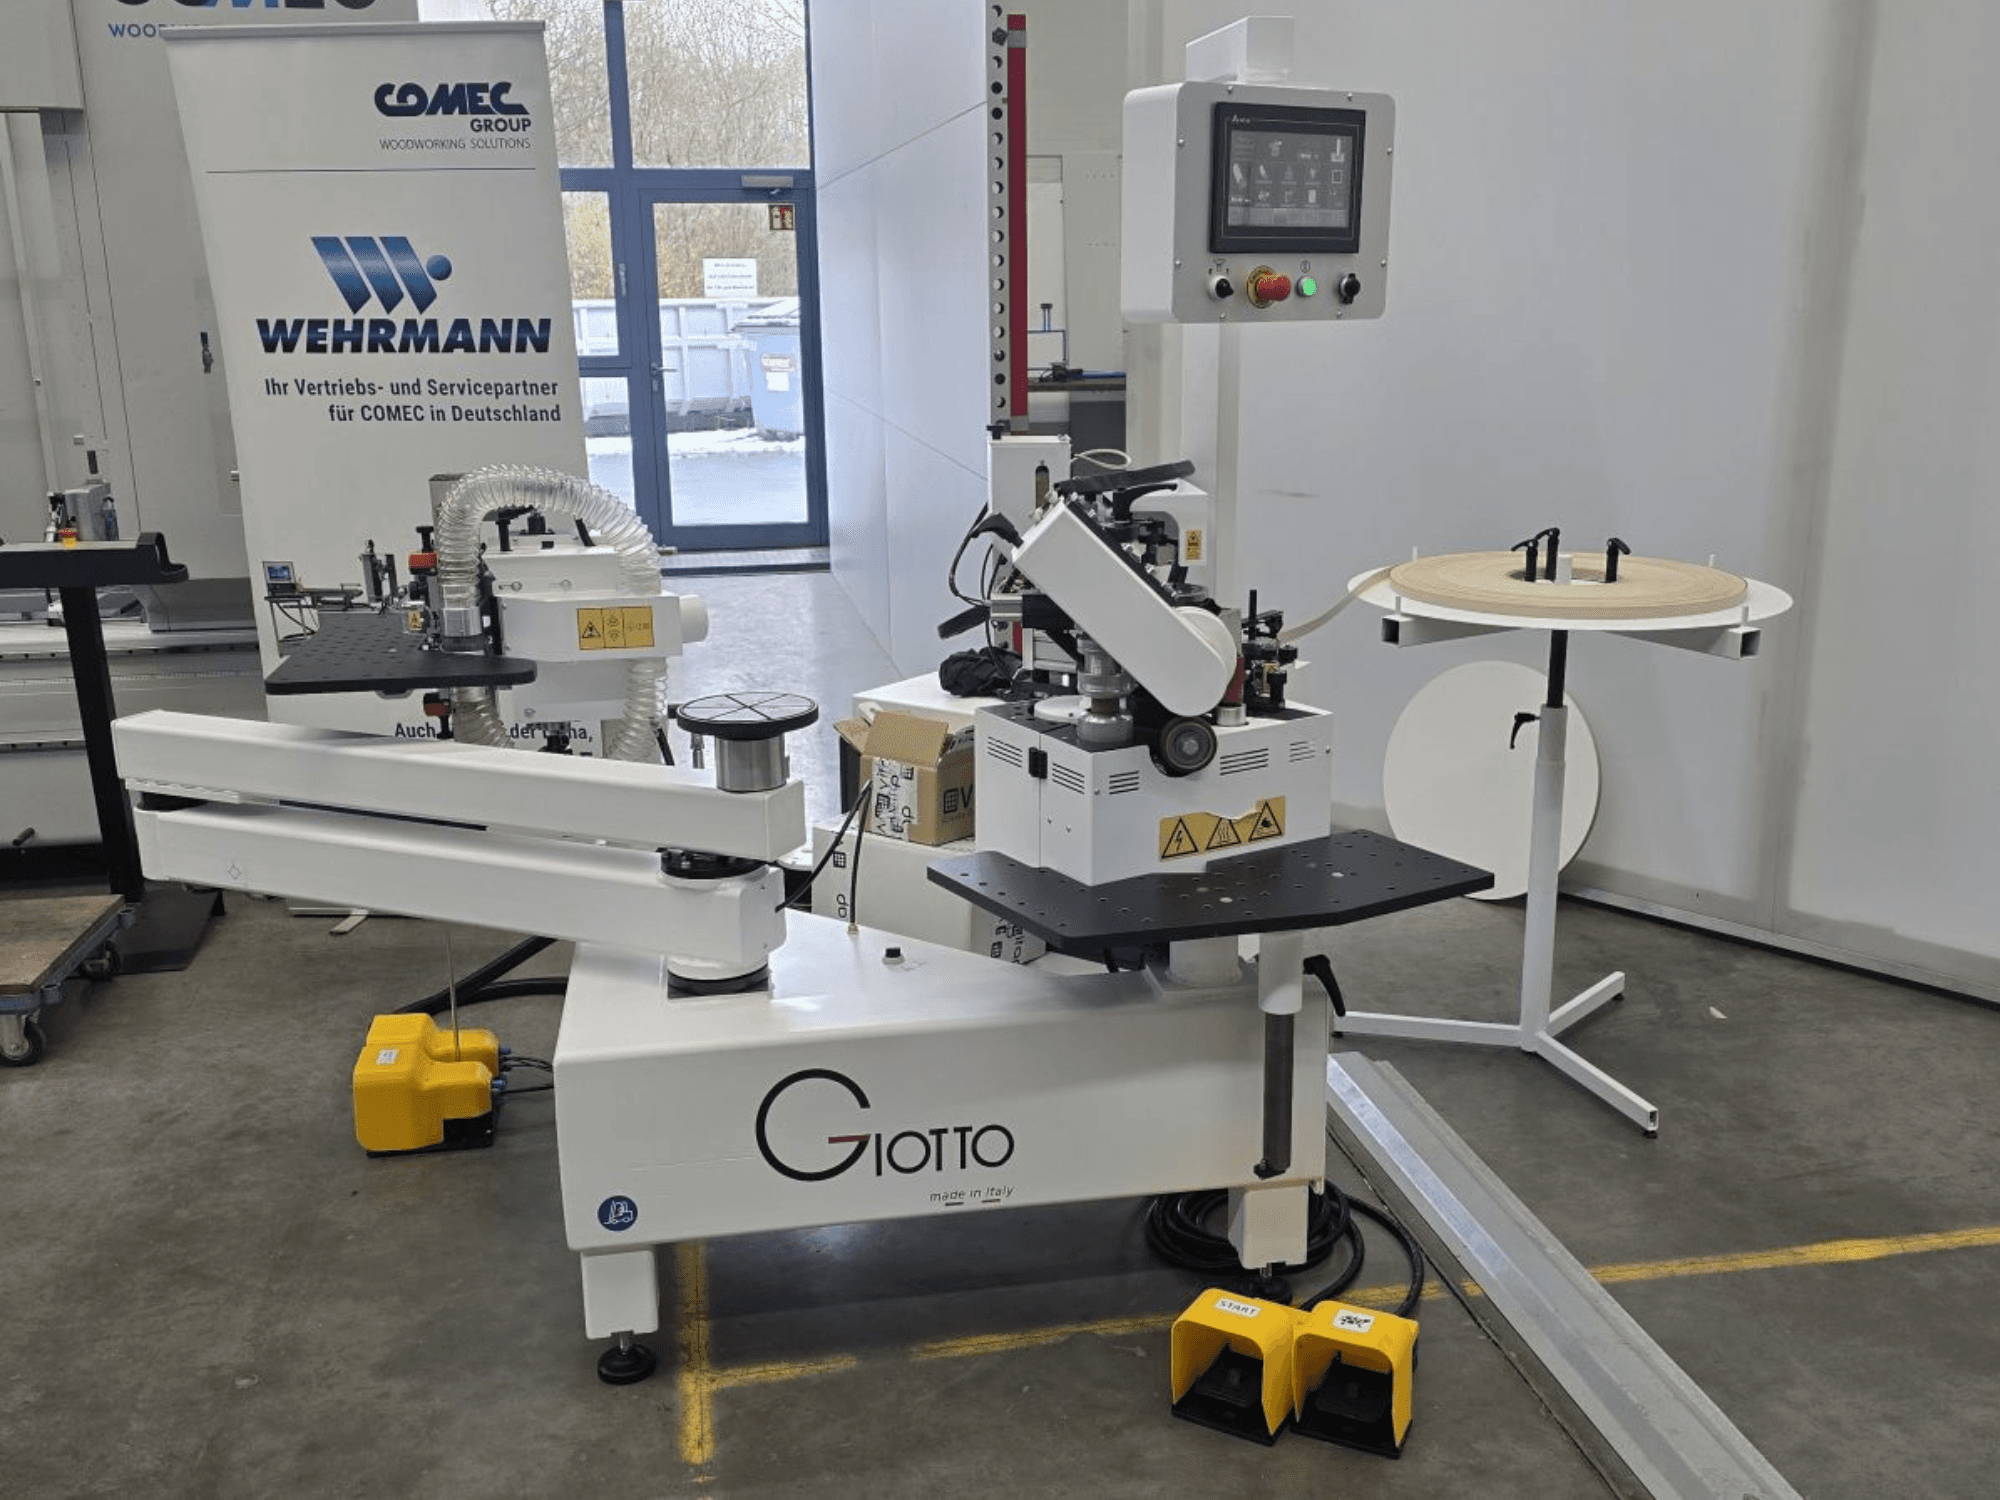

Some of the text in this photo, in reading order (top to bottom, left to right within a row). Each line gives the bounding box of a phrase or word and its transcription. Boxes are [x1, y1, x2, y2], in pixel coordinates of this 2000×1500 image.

[374, 81, 530, 117] COMEC
[470, 118, 532, 132] GROUP
[379, 137, 531, 150] WOODWORKING SOLUTIONS
[256, 318, 551, 354] WEHRMANN
[265, 378, 559, 399] Ihr Vertriebs- und Servicepartner
[328, 404, 562, 423] für COMEC in Deutschland
[394, 721, 436, 738] Auch
[930, 1185, 1014, 1202] made in Italy
[1219, 1299, 1256, 1315] START
